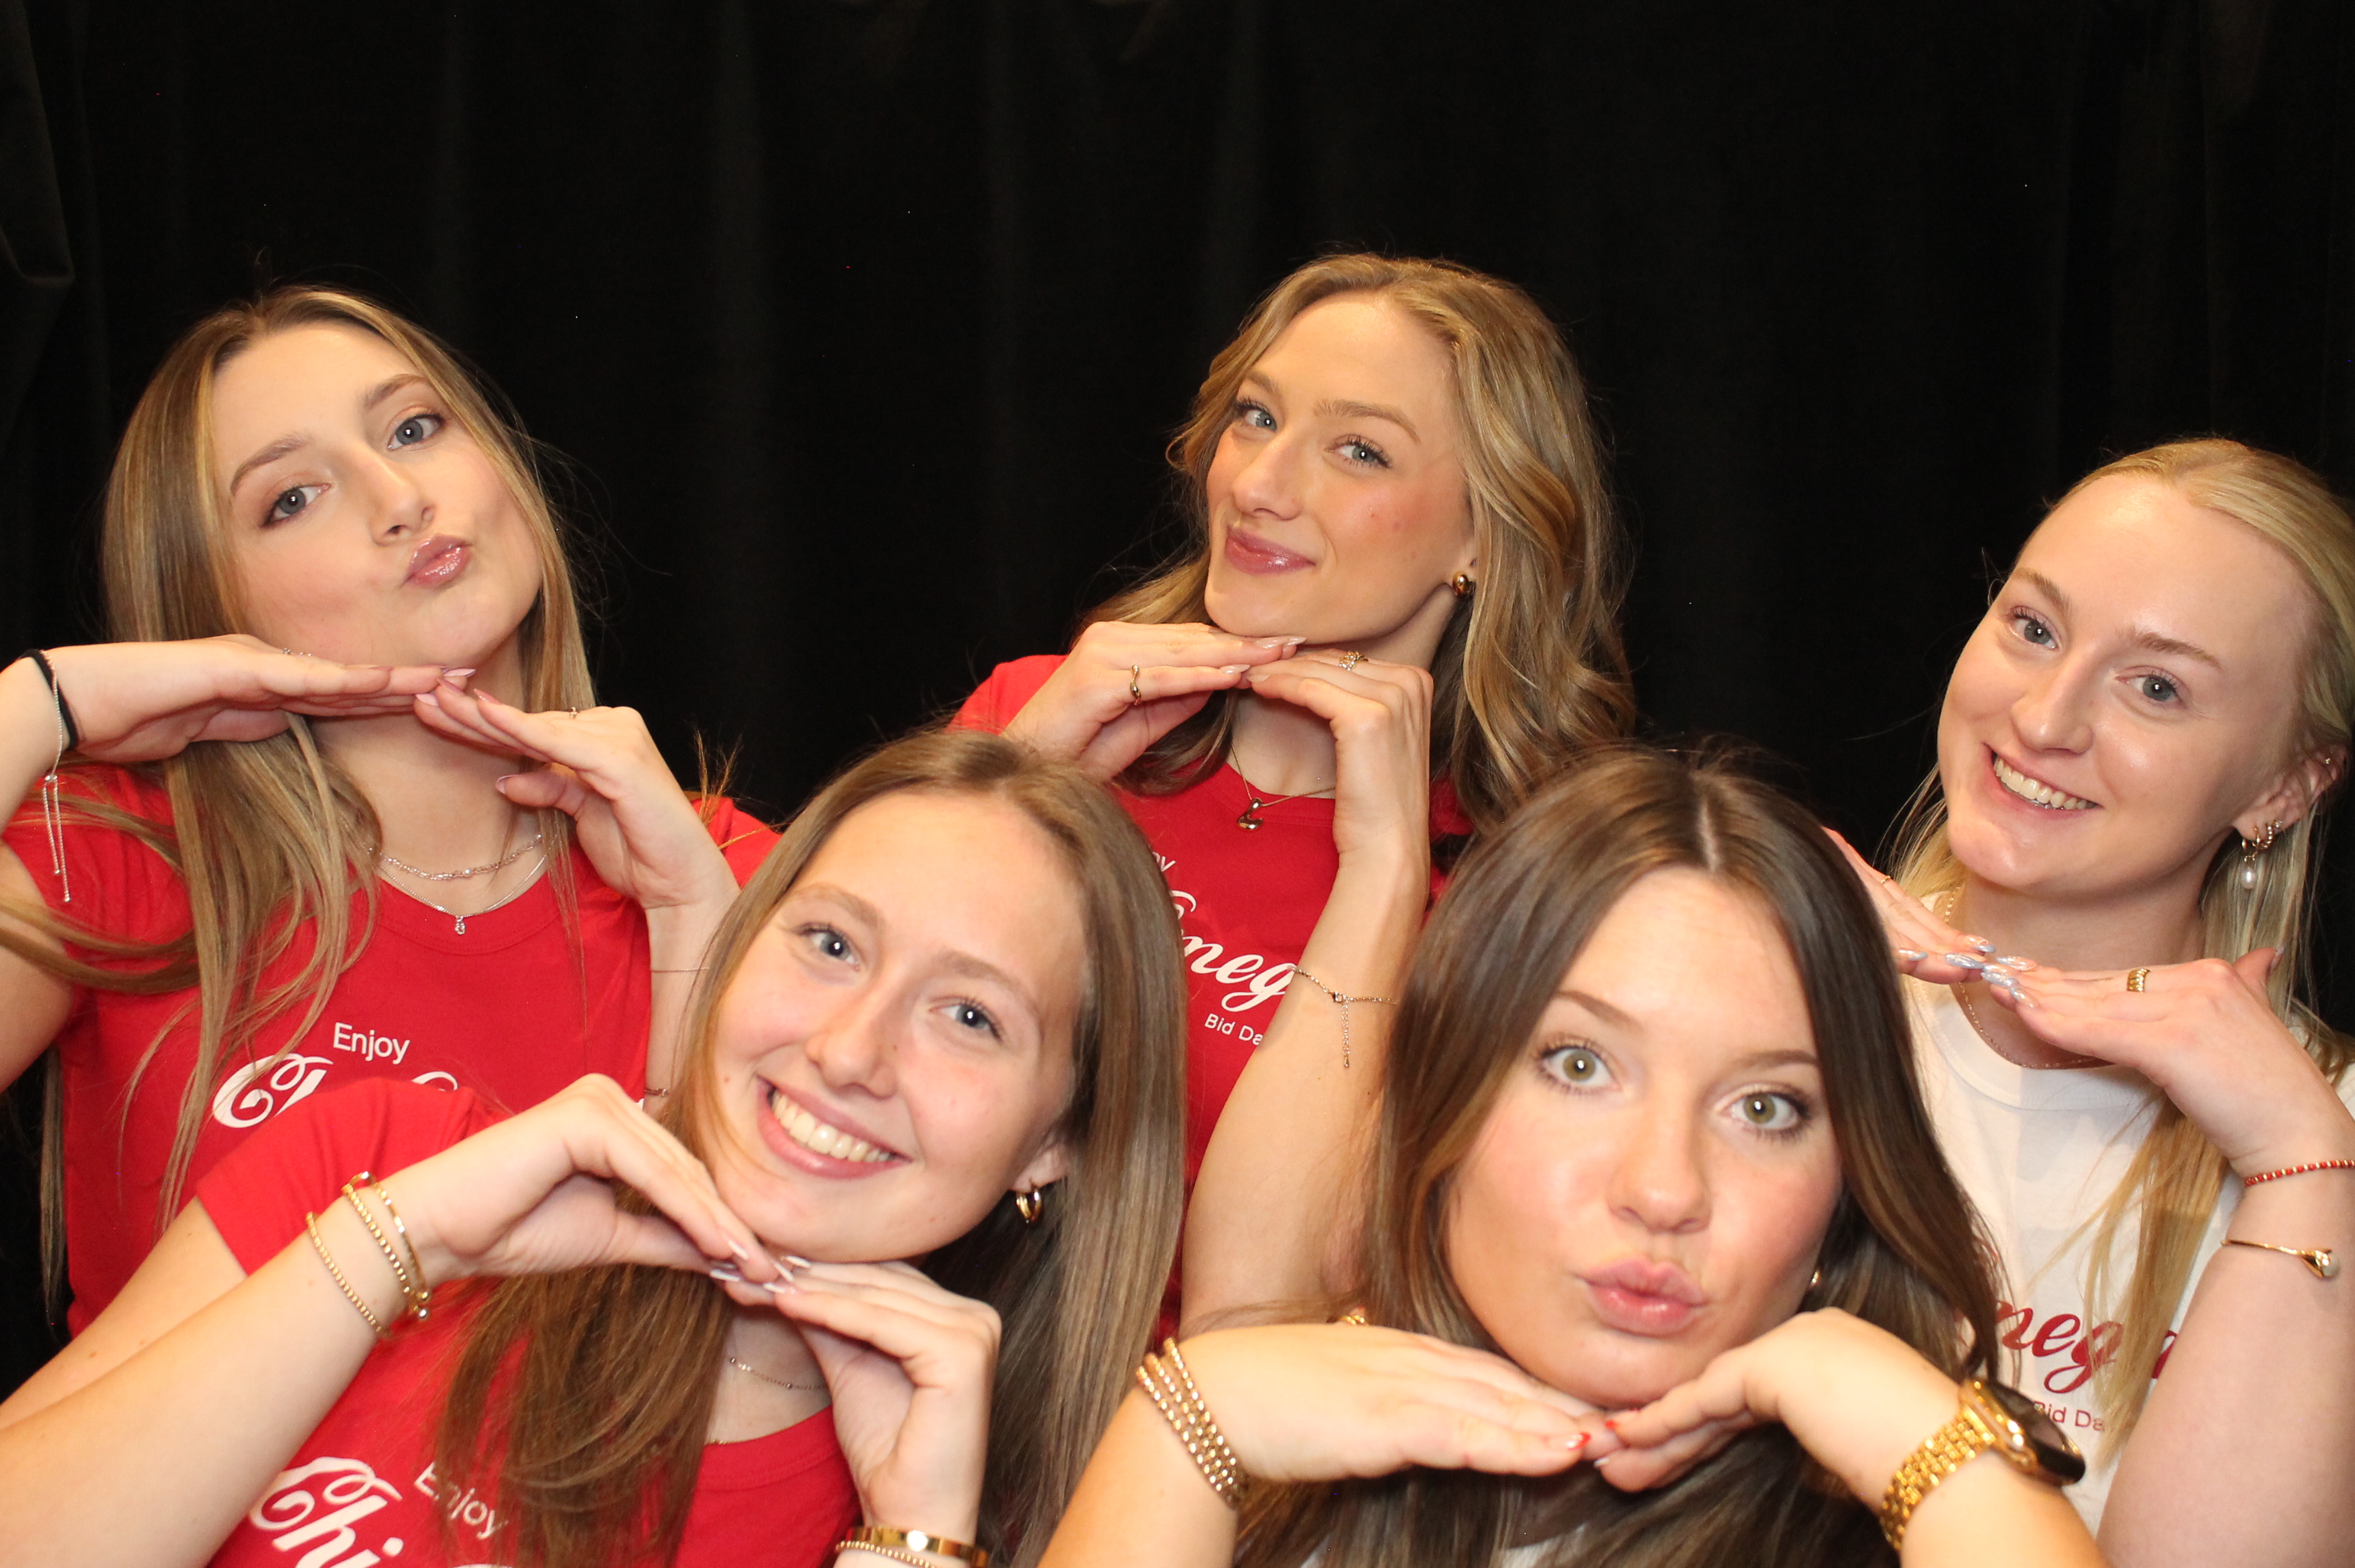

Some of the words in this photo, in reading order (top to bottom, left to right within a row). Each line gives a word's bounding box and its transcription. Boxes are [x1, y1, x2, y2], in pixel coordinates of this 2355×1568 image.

[1171, 890, 1297, 1012] meg
[333, 1022, 410, 1065] Enjoy
[1204, 1013, 1235, 1035] Bid
[1239, 1025, 1263, 1046] Da
[2075, 1409, 2105, 1431] Da
